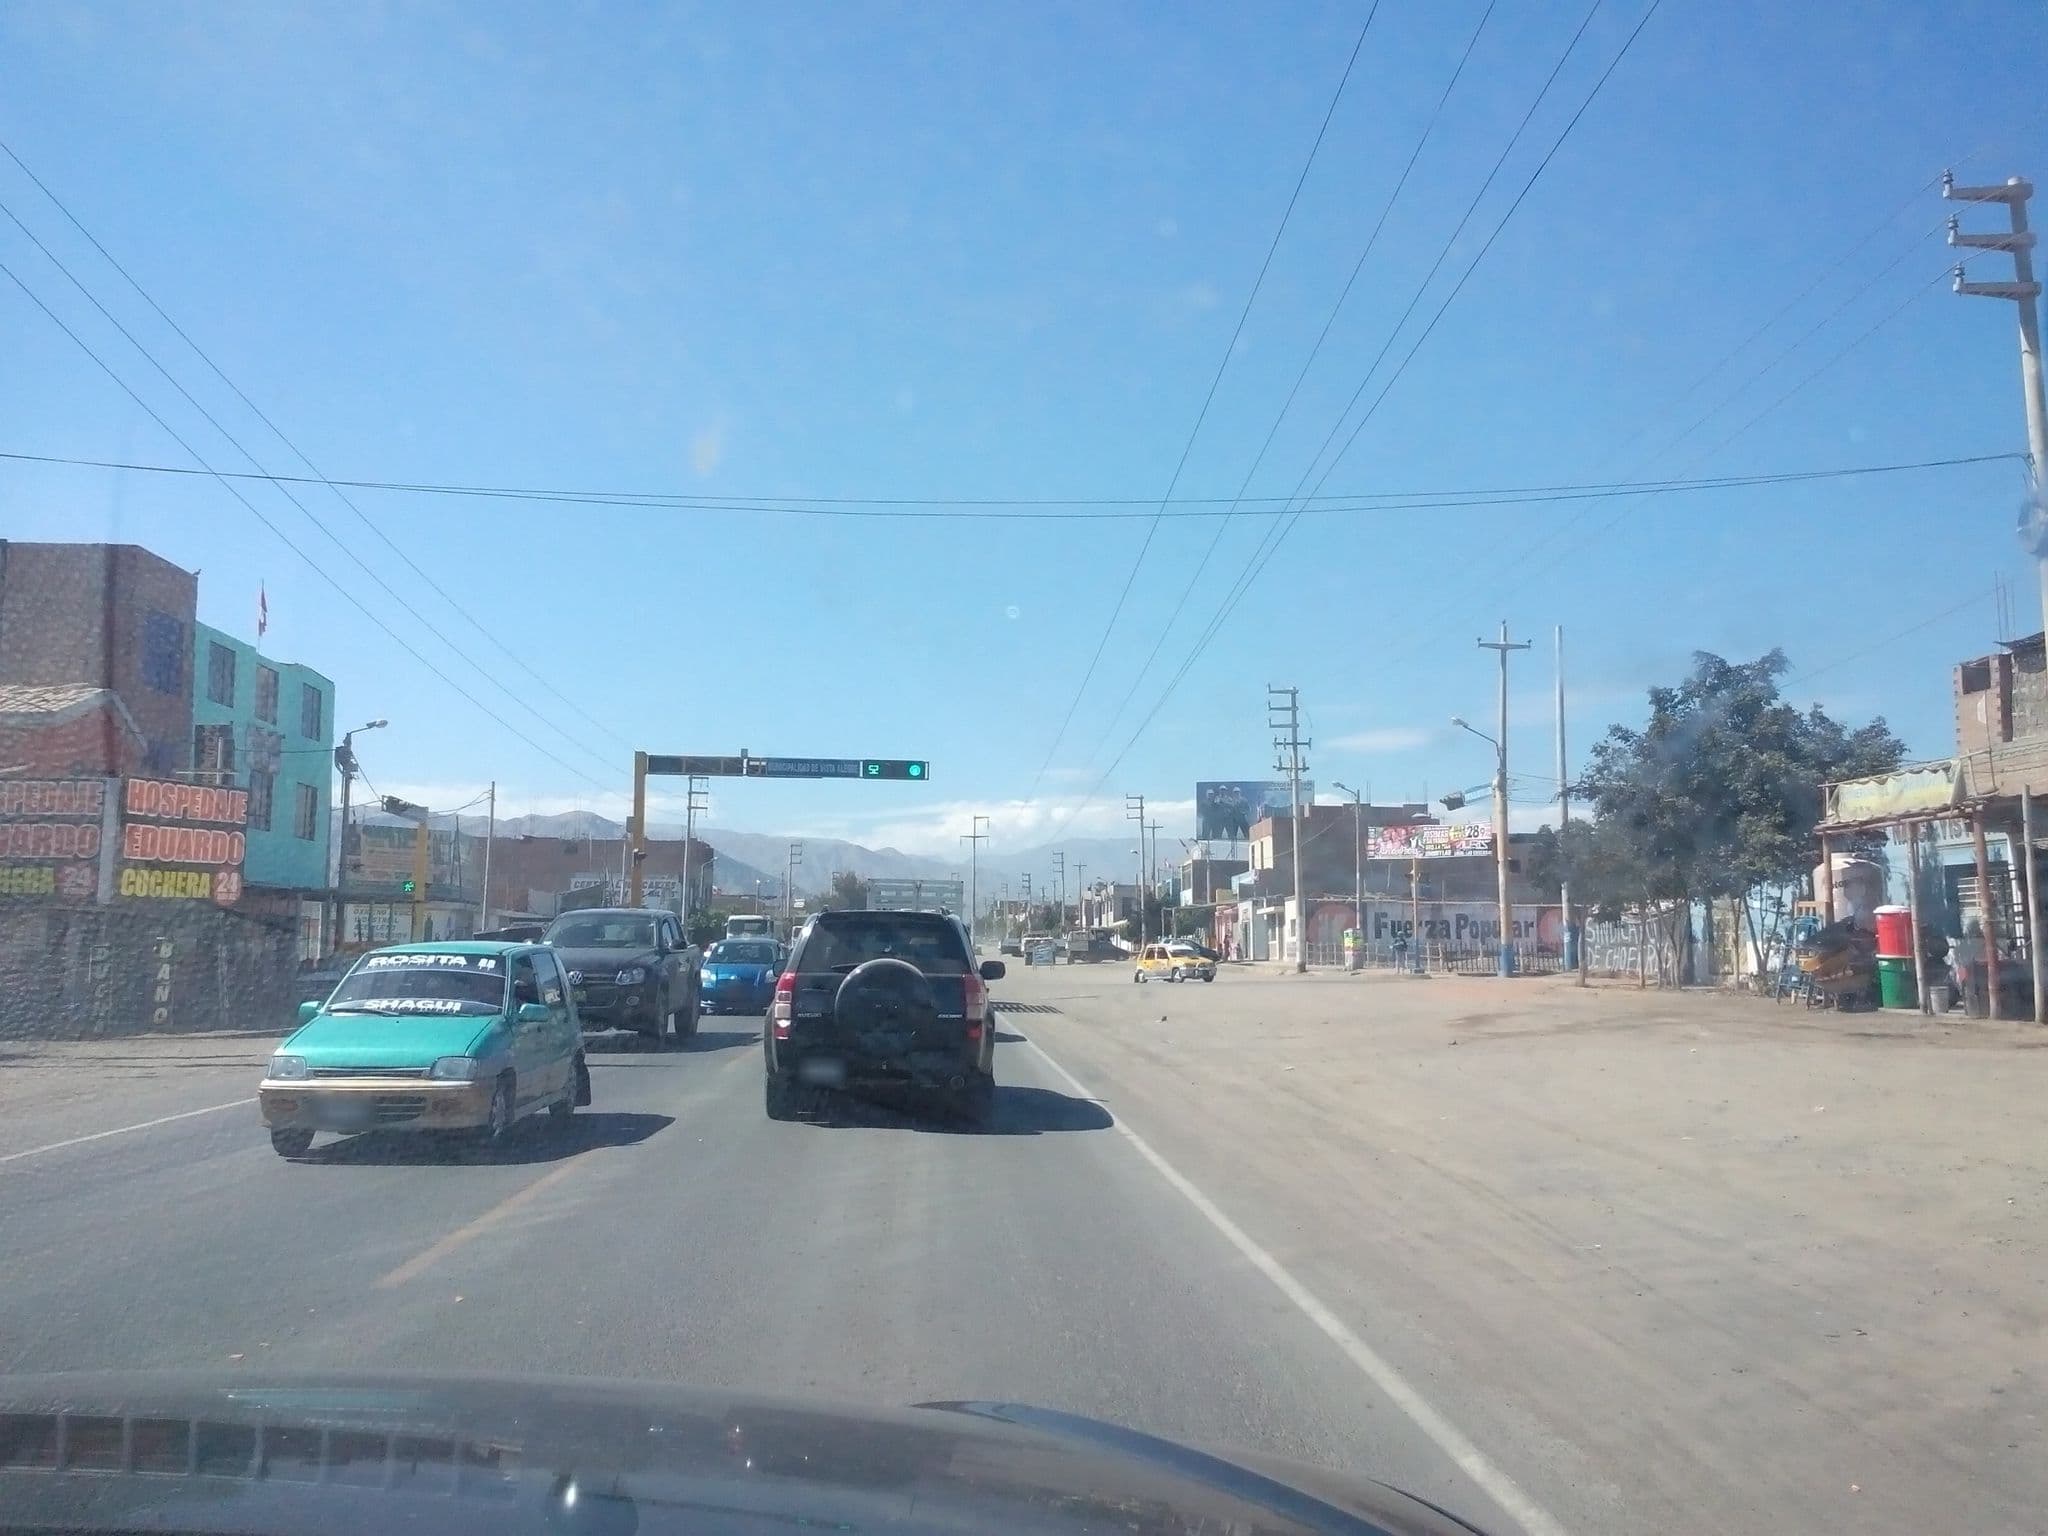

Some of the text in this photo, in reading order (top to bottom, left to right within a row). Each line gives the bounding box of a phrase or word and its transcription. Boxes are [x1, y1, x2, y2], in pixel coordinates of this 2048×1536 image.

[127, 778, 249, 825] HOSPEDAJE
[123, 822, 246, 865] EDUARDO
[120, 867, 238, 898] COCHERA 24
[1455, 913, 1535, 945] Popuar
[367, 954, 467, 968] ROSITA
